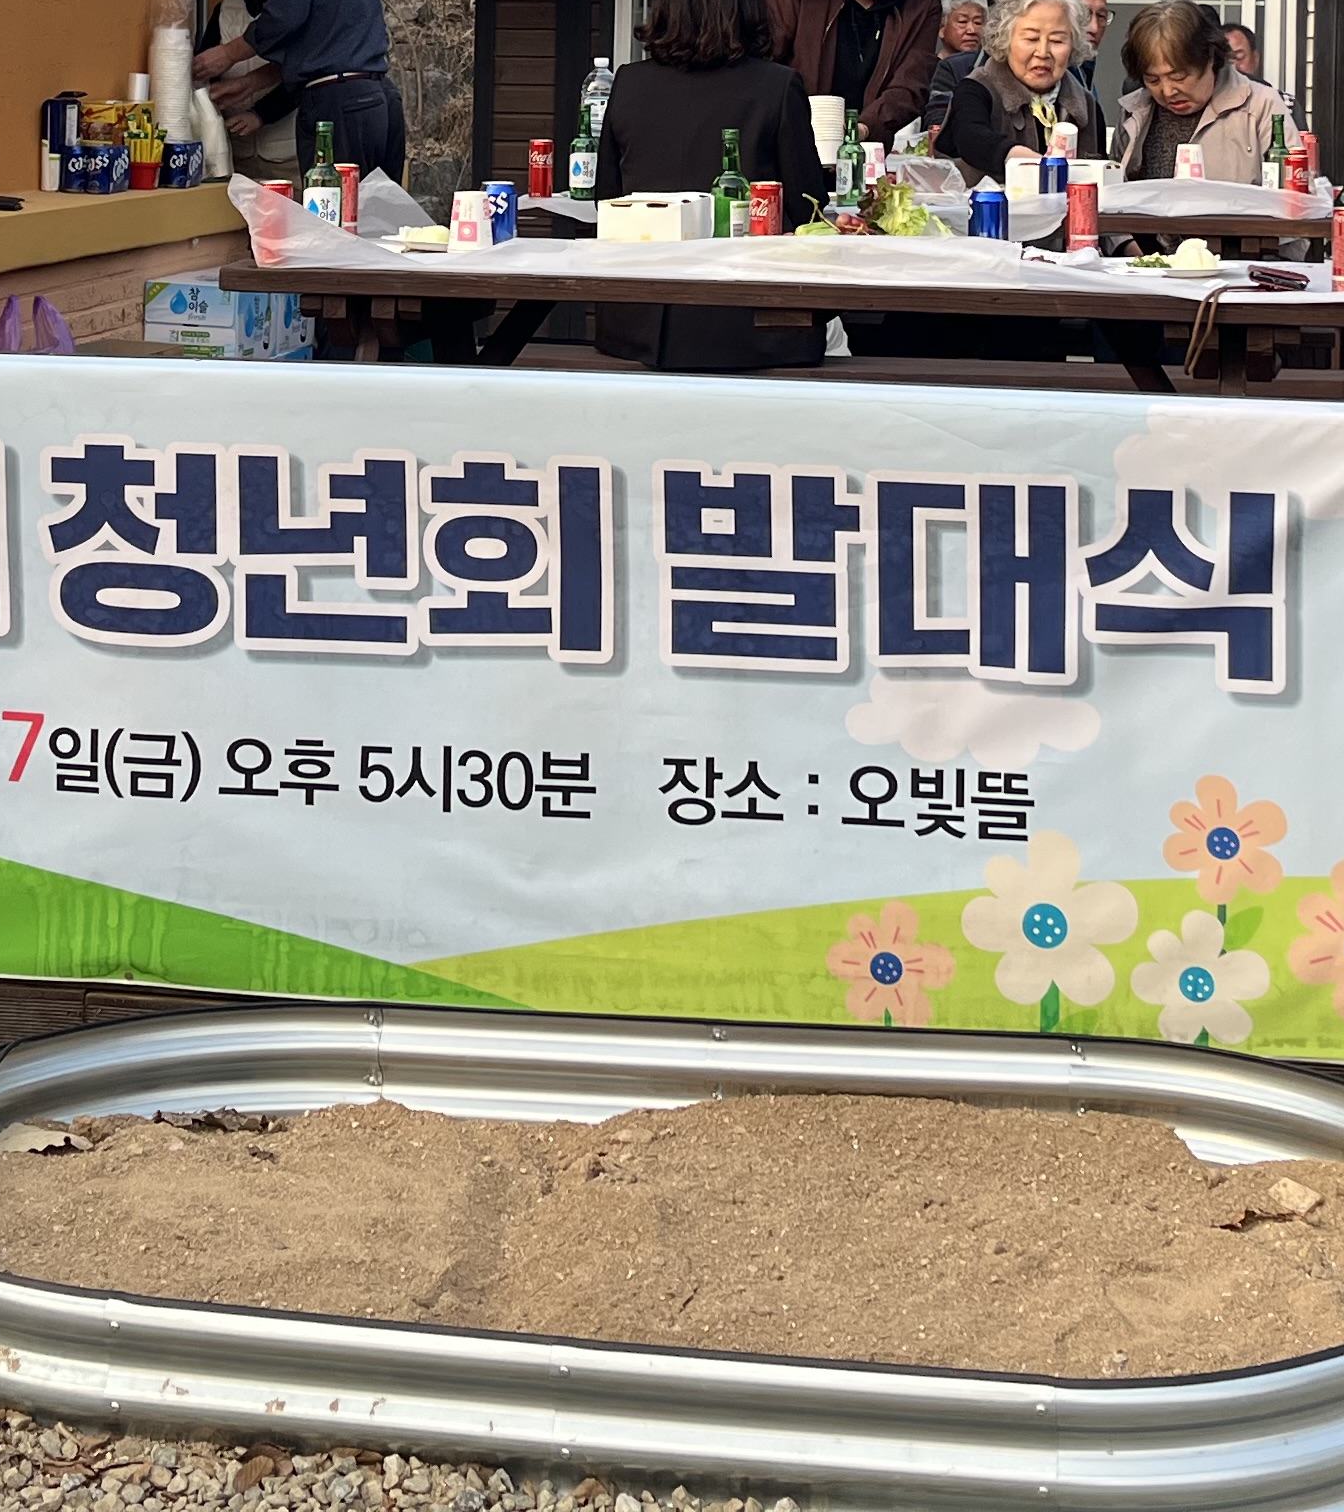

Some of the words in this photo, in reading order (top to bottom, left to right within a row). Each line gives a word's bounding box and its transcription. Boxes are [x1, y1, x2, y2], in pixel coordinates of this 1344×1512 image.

[48, 444, 606, 652] 청년회
[664, 470, 1276, 683] 발대식
[218, 738, 340, 806] 오후
[358, 745, 597, 820] 5시30분
[659, 756, 784, 826] 장소
[841, 765, 1035, 842] 오빛뜰
